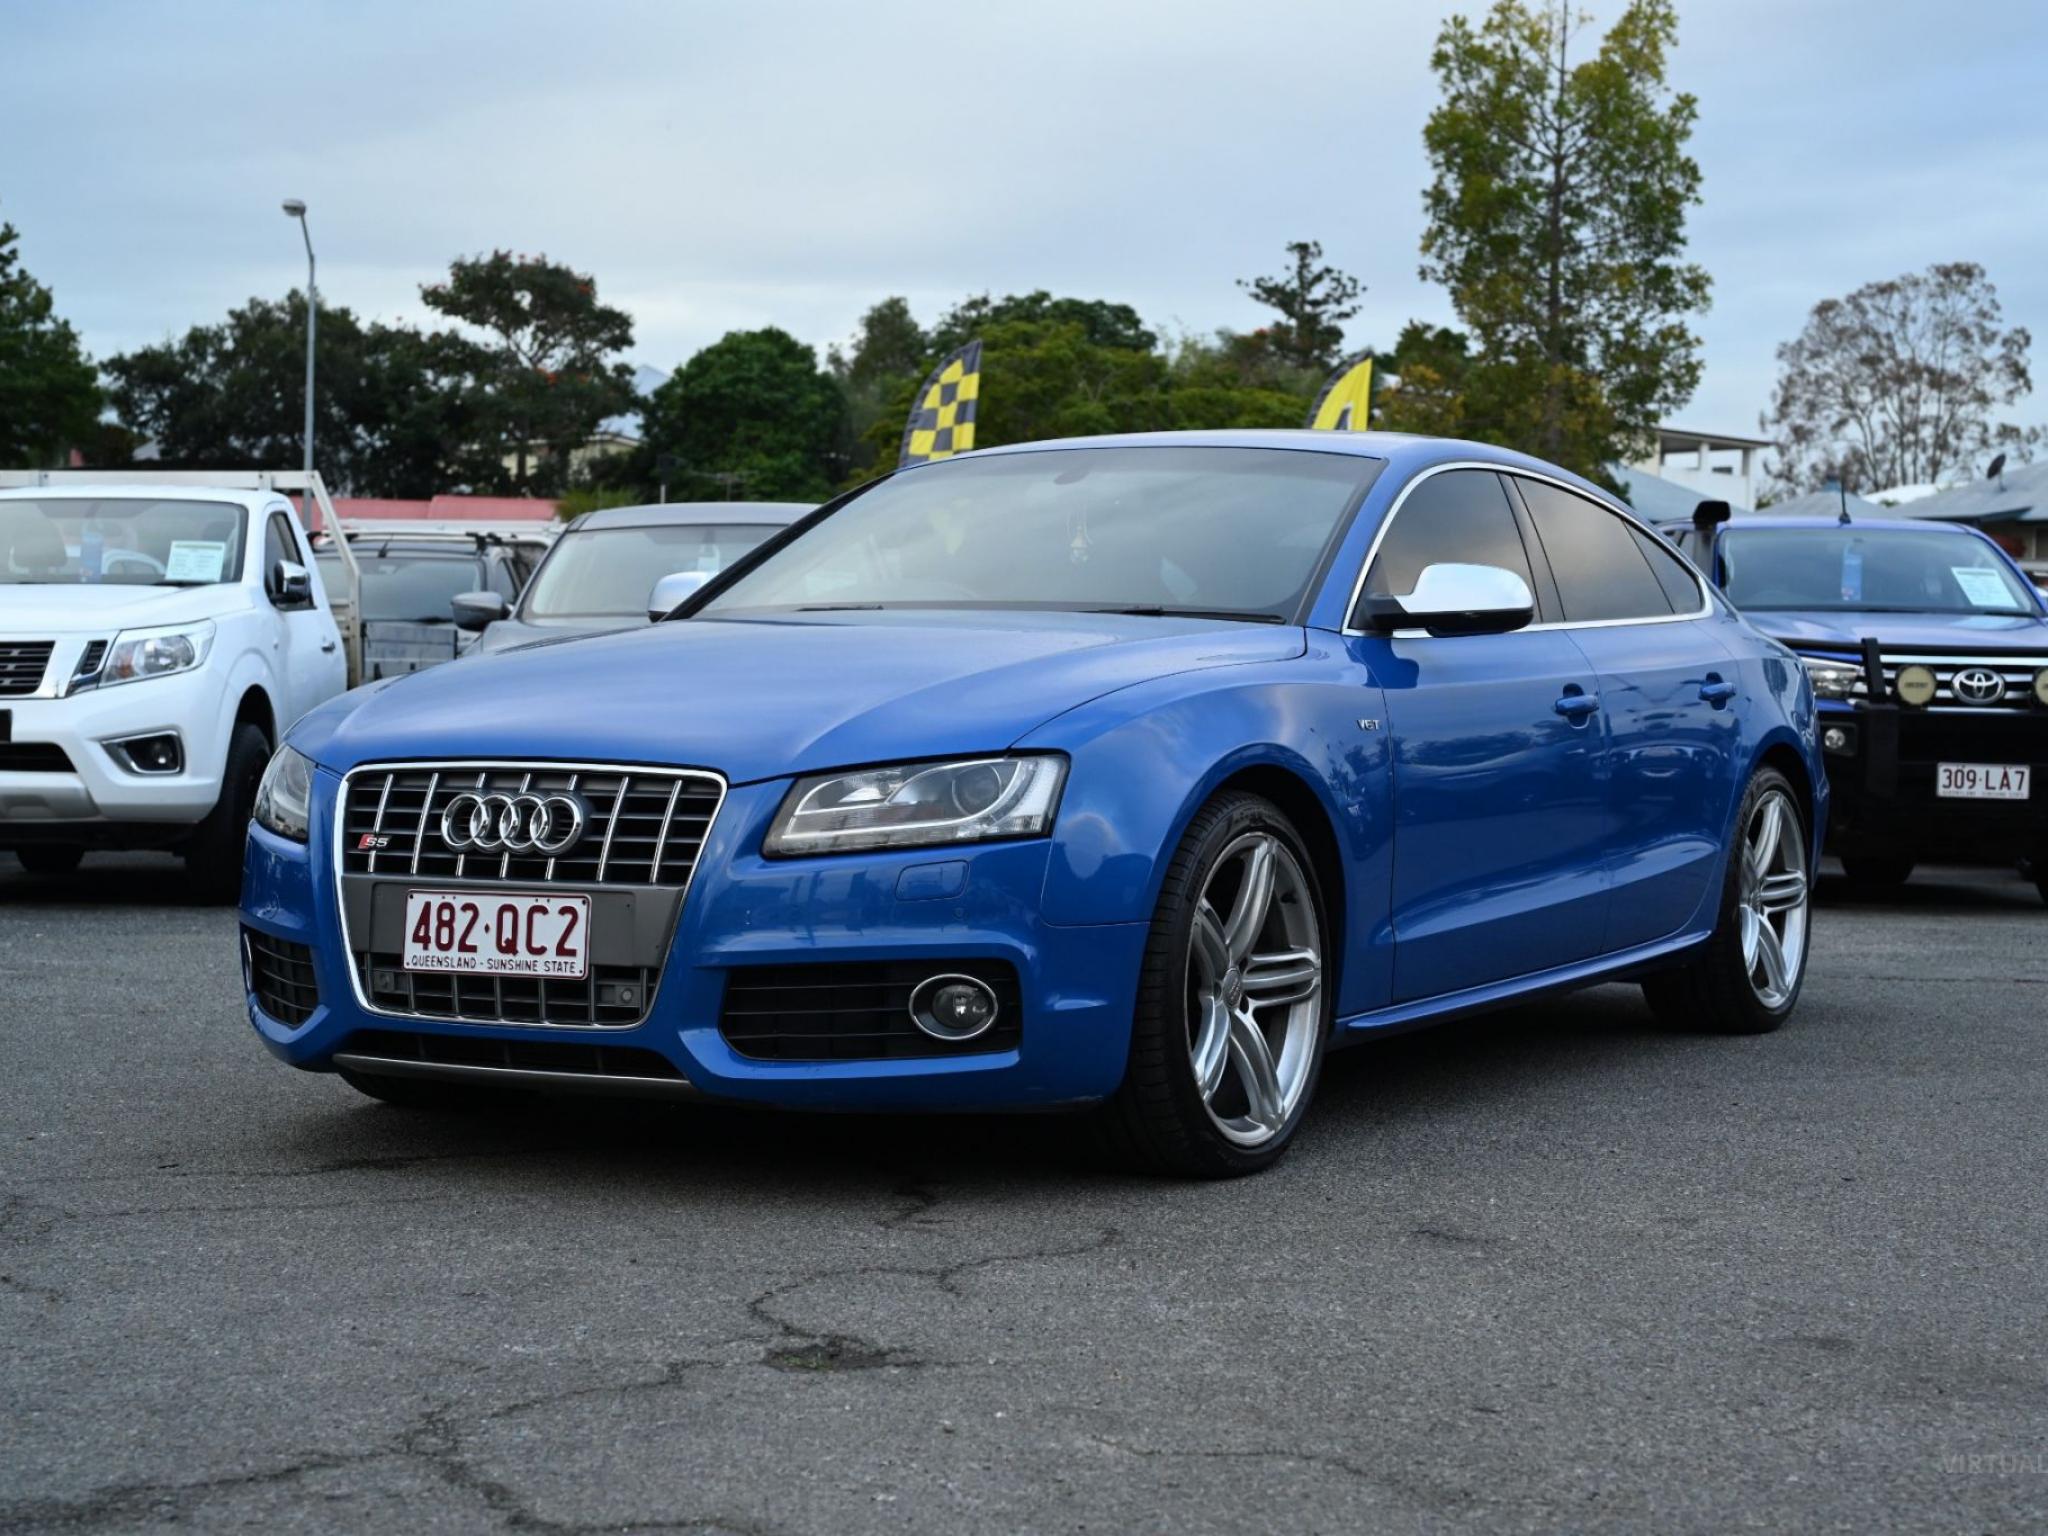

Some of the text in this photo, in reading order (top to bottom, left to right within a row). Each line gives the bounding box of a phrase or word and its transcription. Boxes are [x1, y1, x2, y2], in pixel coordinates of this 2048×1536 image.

[362, 836, 389, 848] S5
[411, 954, 476, 970] QUEENSLAND
[486, 958, 538, 972] SUNSHINE
[543, 960, 576, 974] STATE
